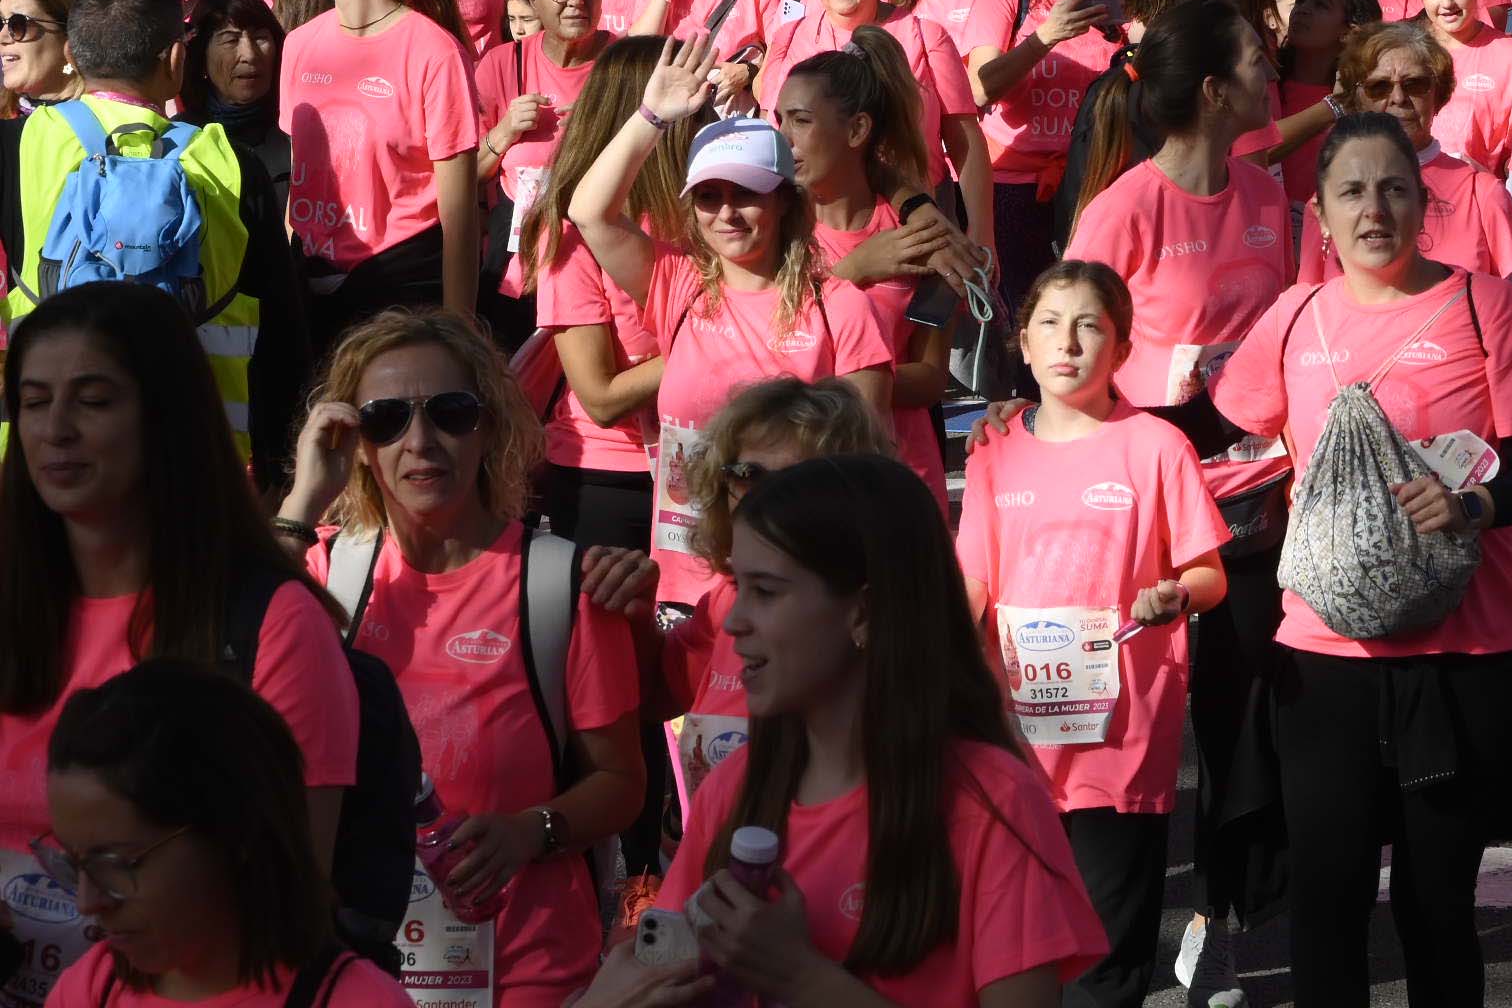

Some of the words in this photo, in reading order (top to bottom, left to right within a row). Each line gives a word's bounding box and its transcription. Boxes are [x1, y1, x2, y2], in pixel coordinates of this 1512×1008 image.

[603, 14, 626, 32] TU
[301, 71, 333, 85] OYSHO
[1080, 622, 1109, 632] SUMA
[1019, 632, 1071, 644] ASTURIANA
[1024, 662, 1073, 682] 016
[1030, 686, 1070, 700] 31572
[1034, 705, 1048, 713] DE
[1048, 705, 1060, 713] LA
[1061, 703, 1091, 712] MUJER
[403, 919, 426, 944] 6
[404, 975, 444, 985] MUJER
[447, 975, 473, 984] 2023
